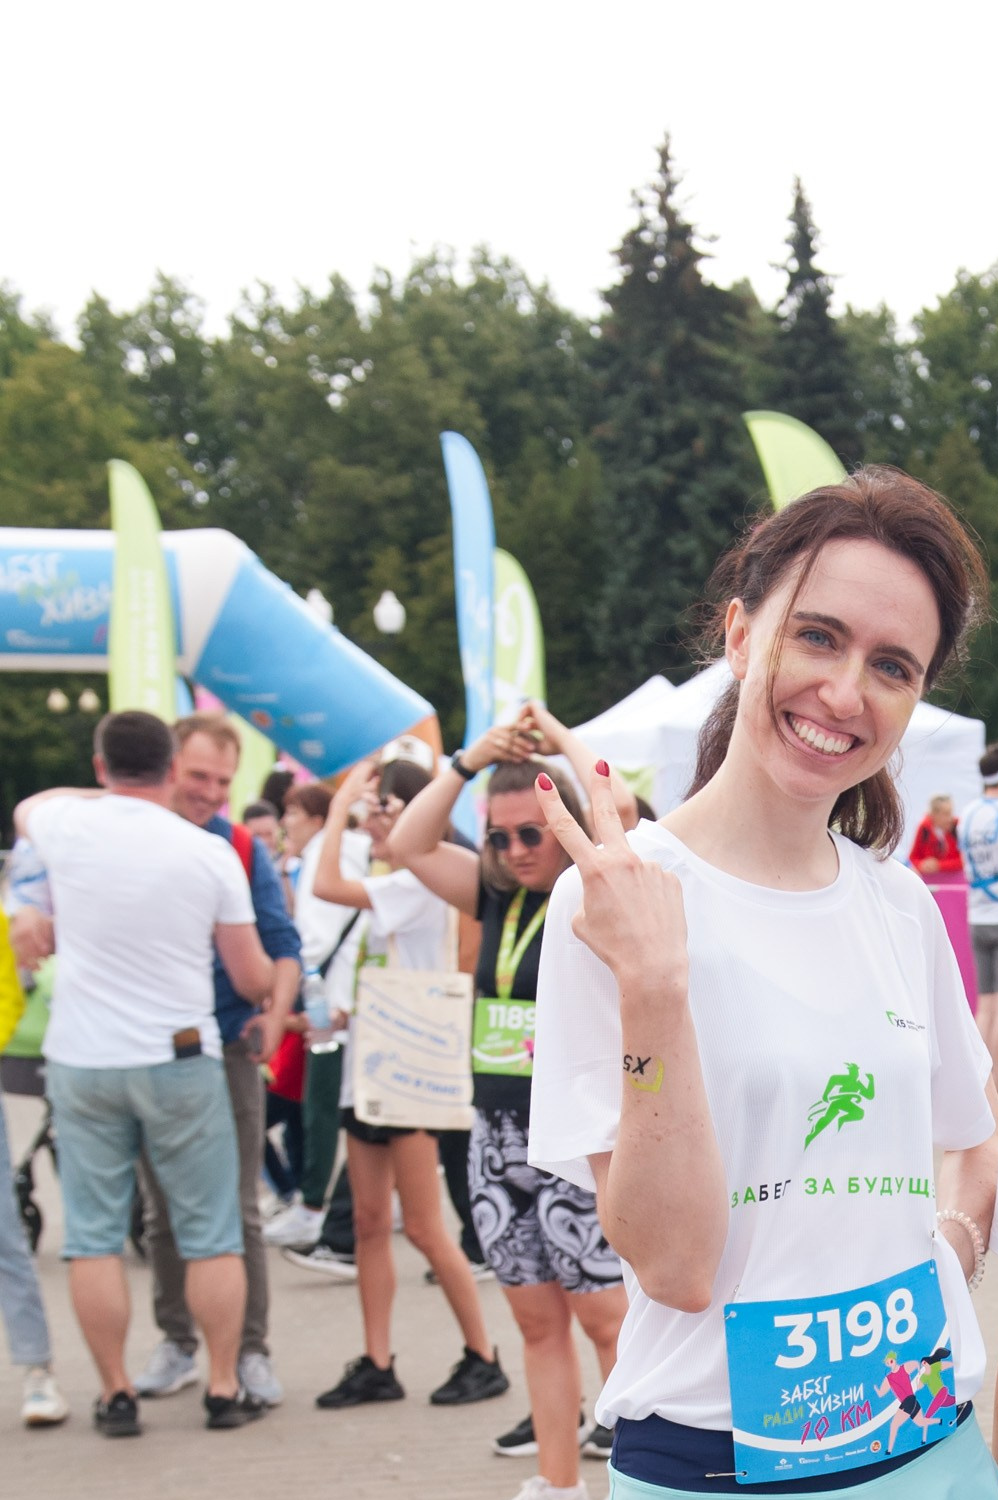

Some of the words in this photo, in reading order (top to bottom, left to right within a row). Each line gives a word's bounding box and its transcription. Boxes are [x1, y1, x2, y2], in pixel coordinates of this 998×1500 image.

[804, 1177, 836, 1195] ЗА
[847, 1176, 936, 1199] БУДУЩ
[774, 1288, 918, 1369] 3198
[763, 1405, 804, 1428] РАДИ
[807, 1383, 864, 1418] ЖИЗНИ
[781, 1375, 832, 1406] ЗАБЕГ
[801, 1416, 830, 1445] 10
